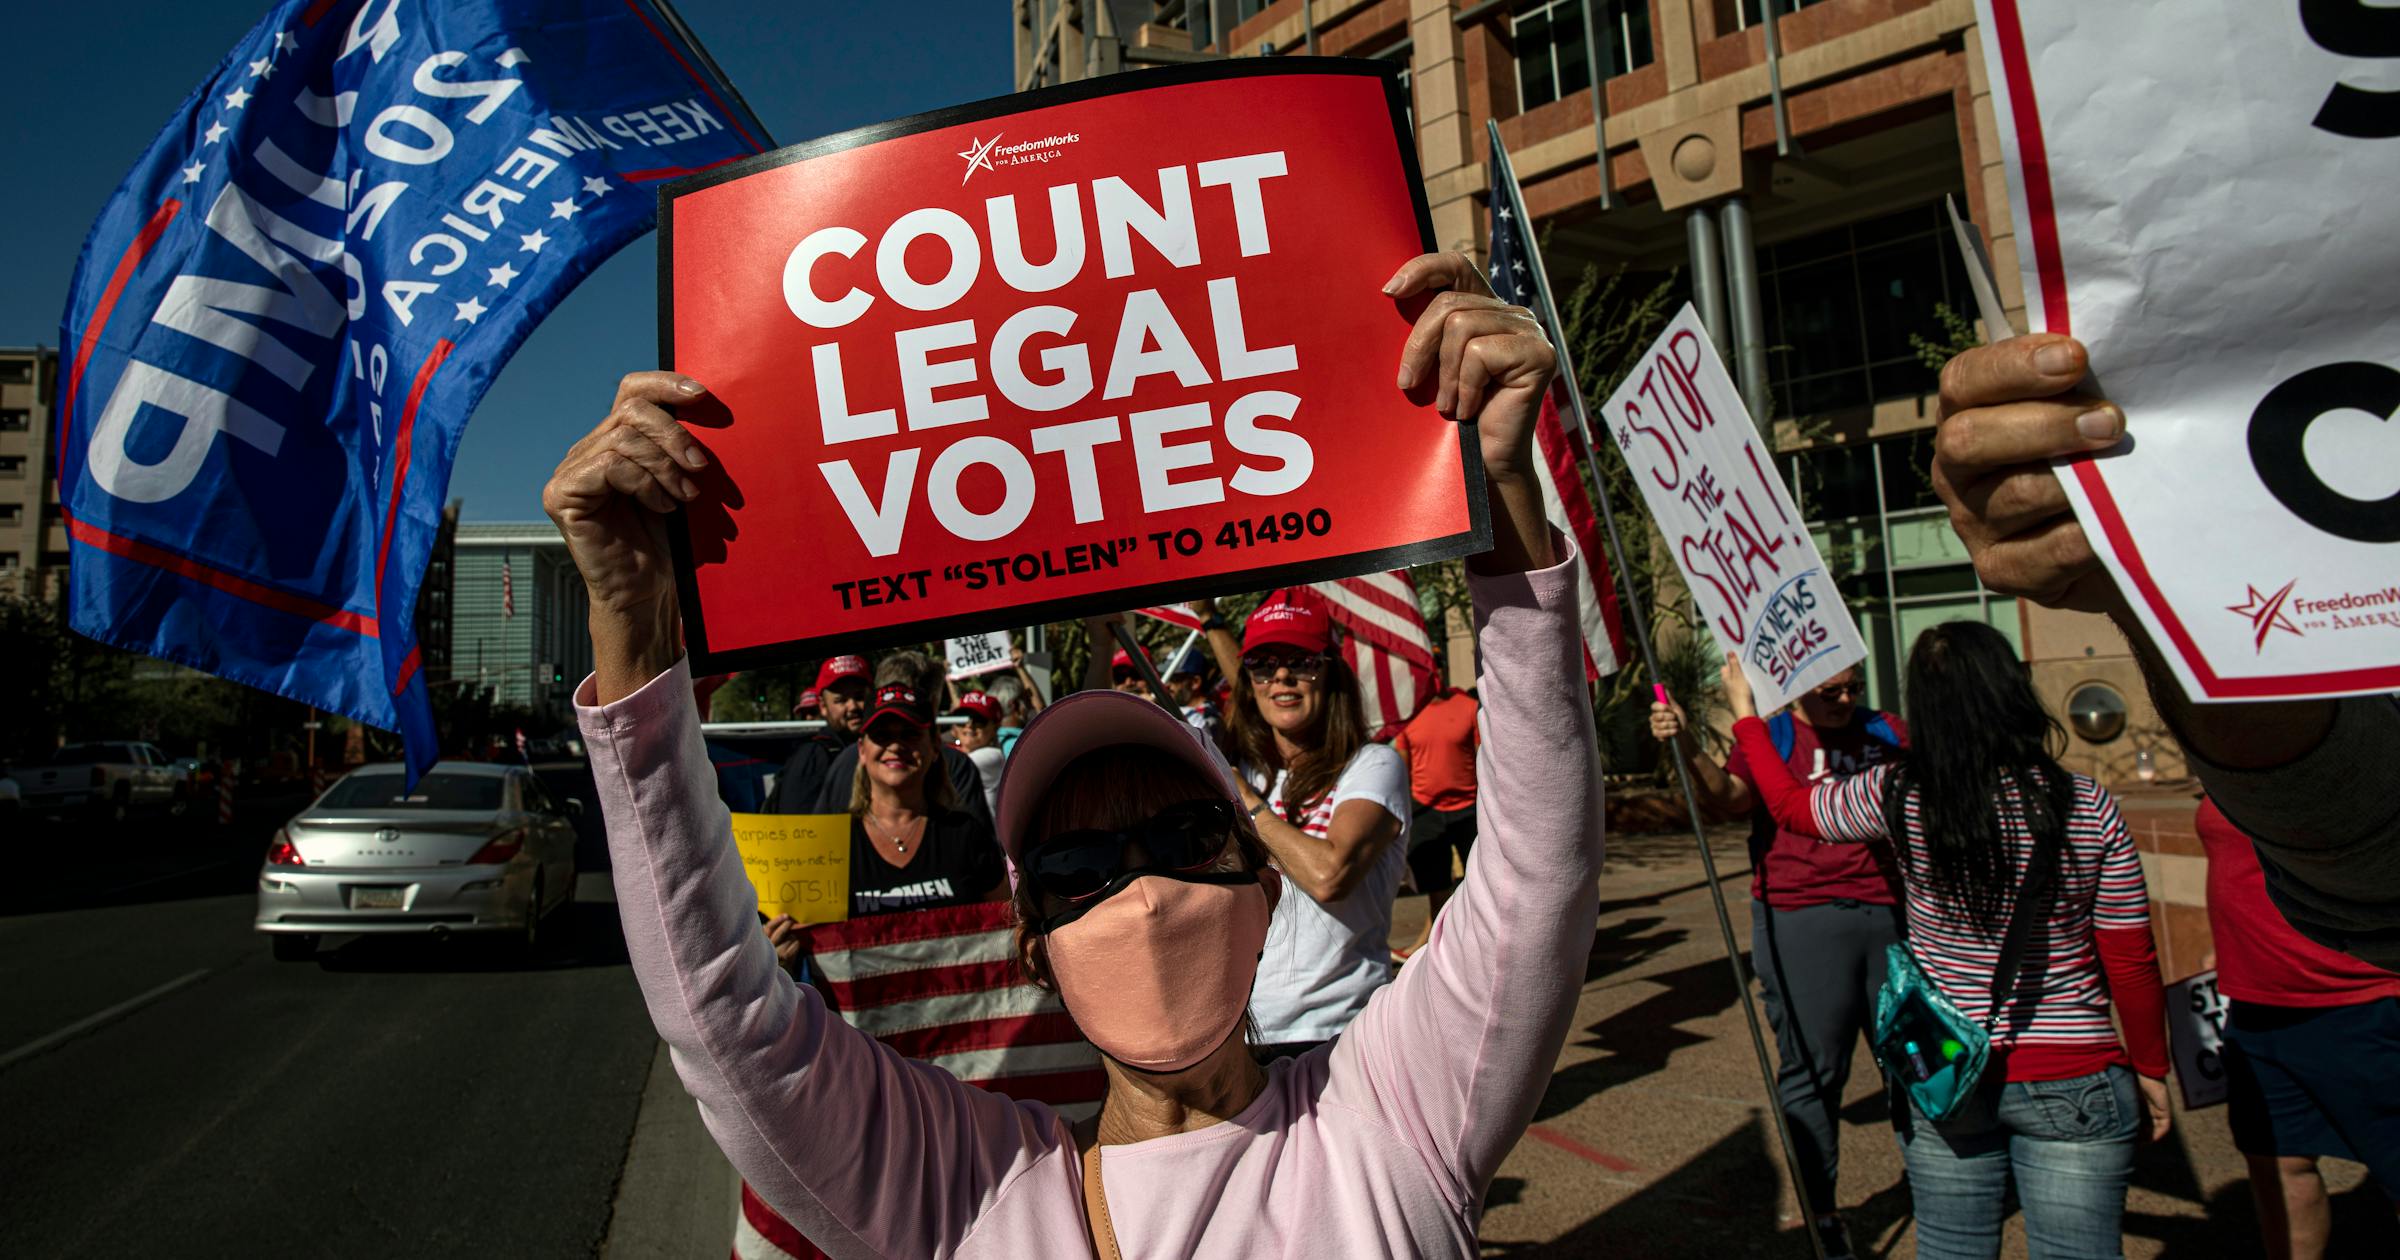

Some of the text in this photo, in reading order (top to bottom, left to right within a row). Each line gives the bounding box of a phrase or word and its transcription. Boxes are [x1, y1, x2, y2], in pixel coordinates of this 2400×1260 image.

[995, 132, 1080, 157] FreedomWorks
[1010, 150, 1062, 166] AMERICA
[783, 151, 1288, 328] COUNT
[811, 277, 1298, 445] LEGAL
[818, 391, 1313, 557] VOTES
[1682, 464, 1726, 522] THE
[832, 569, 932, 609] TEXT
[1149, 527, 1203, 560] TO
[1216, 508, 1332, 549] 41490
[2295, 585, 2400, 615] FreedomW
[2331, 611, 2400, 630] AMERI
[960, 638, 990, 655] THE
[1754, 579, 1818, 674] FOX NEWS
[955, 646, 1003, 668] CHEAT
[1769, 619, 1829, 687] SUCKS
[792, 827, 817, 840] are
